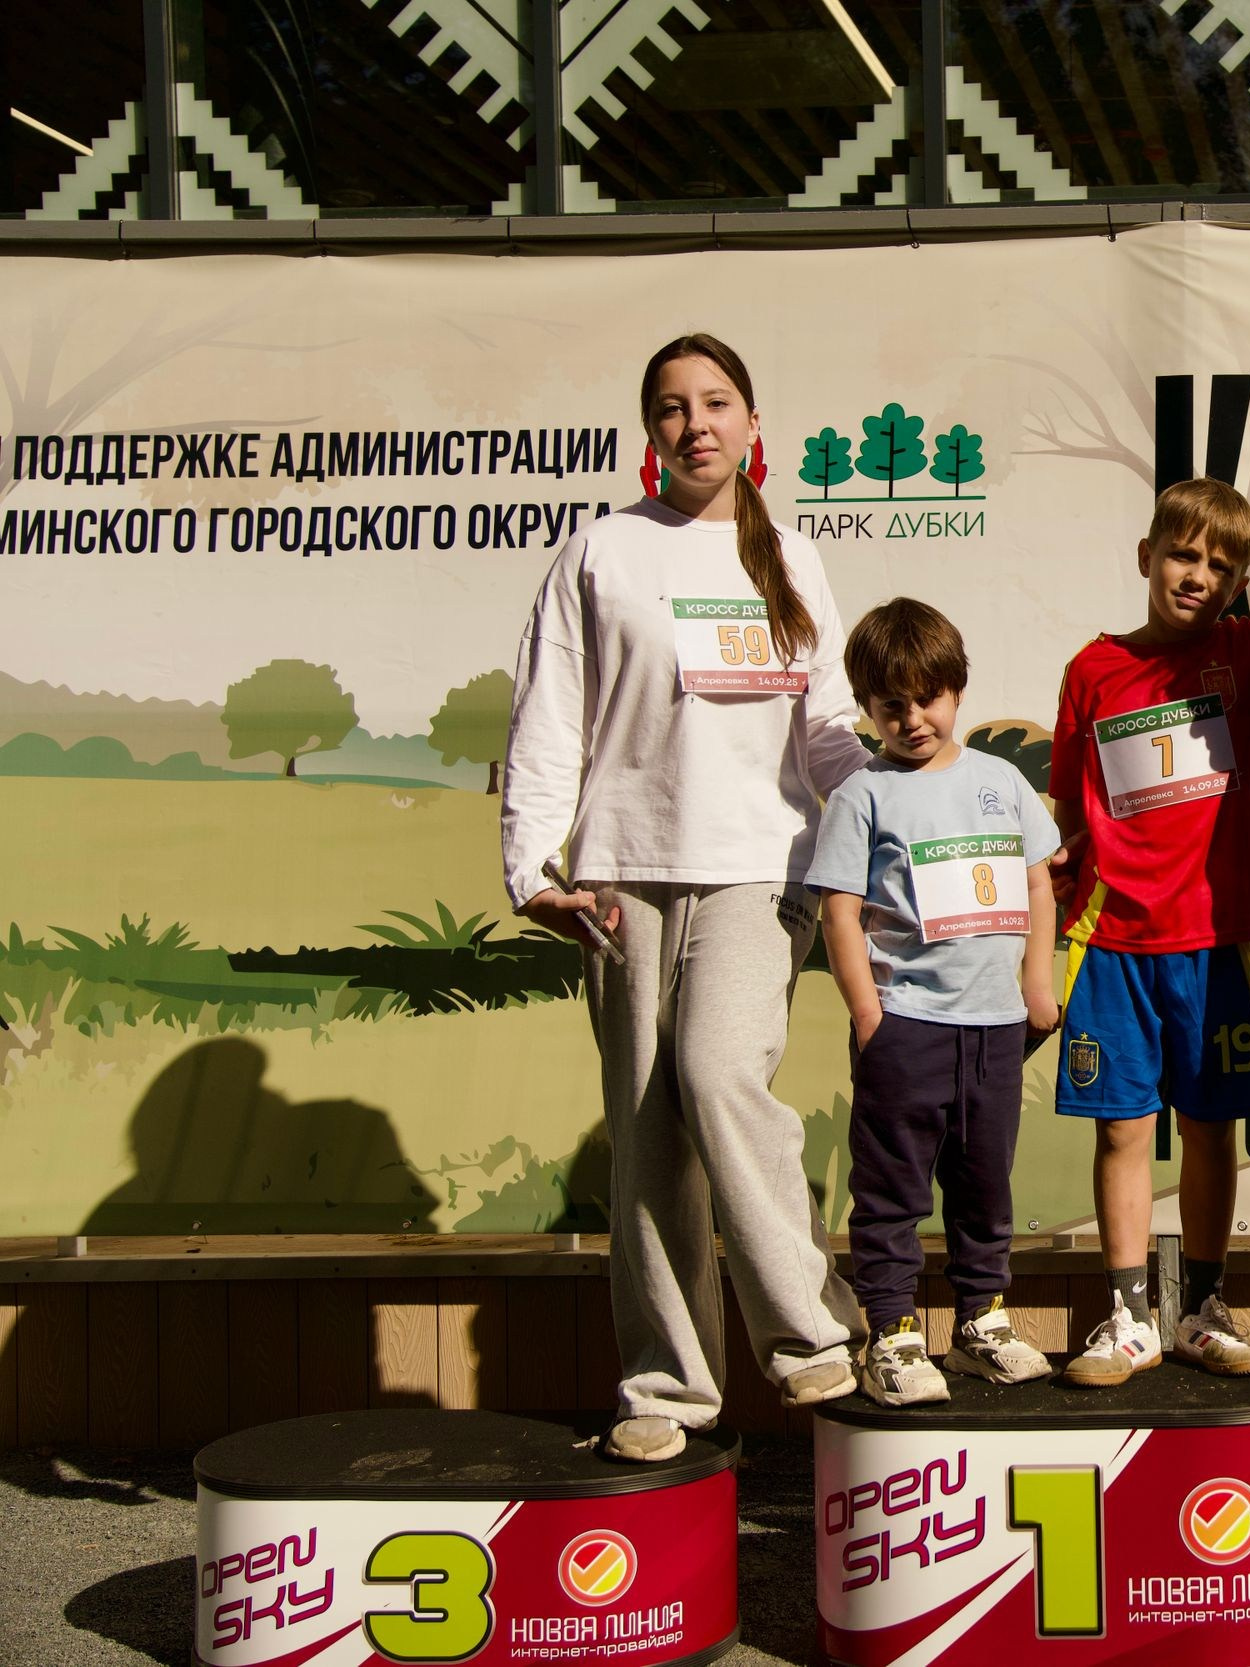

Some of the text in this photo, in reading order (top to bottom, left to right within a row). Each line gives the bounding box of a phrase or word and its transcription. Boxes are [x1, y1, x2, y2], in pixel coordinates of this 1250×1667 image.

[13, 428, 618, 486] ПОДДЕРЖКЕ АДМИНИСТРАЦИИ
[208, 504, 456, 557] ГОРОДСКОГО
[797, 511, 985, 540] ПАРК ДУБКИ
[686, 604, 768, 617] КРОСС ДУБ
[717, 625, 771, 666] 59
[697, 676, 798, 687] Апрелевка 14.09.25
[1108, 703, 1211, 737] КРОСС ДУБКИ
[1124, 777, 1226, 808] Апрелевка 14.09.25
[925, 840, 1017, 859] КРОСС ДУБКИ
[972, 863, 998, 906] 8
[771, 893, 796, 912] FOCUS
[939, 916, 1025, 932] Апрелевка 14.09.25
[842, 1495, 986, 1592] SKY
[1005, 1464, 1106, 1639] 1
[362, 1530, 497, 1665] 3
[1128, 1575, 1223, 1606] НОВАЯ
[212, 1568, 335, 1649] SKY
[511, 1601, 684, 1644] НОВАЯ ЛИНИЯ
[511, 1630, 684, 1659] интернет-провайдер
